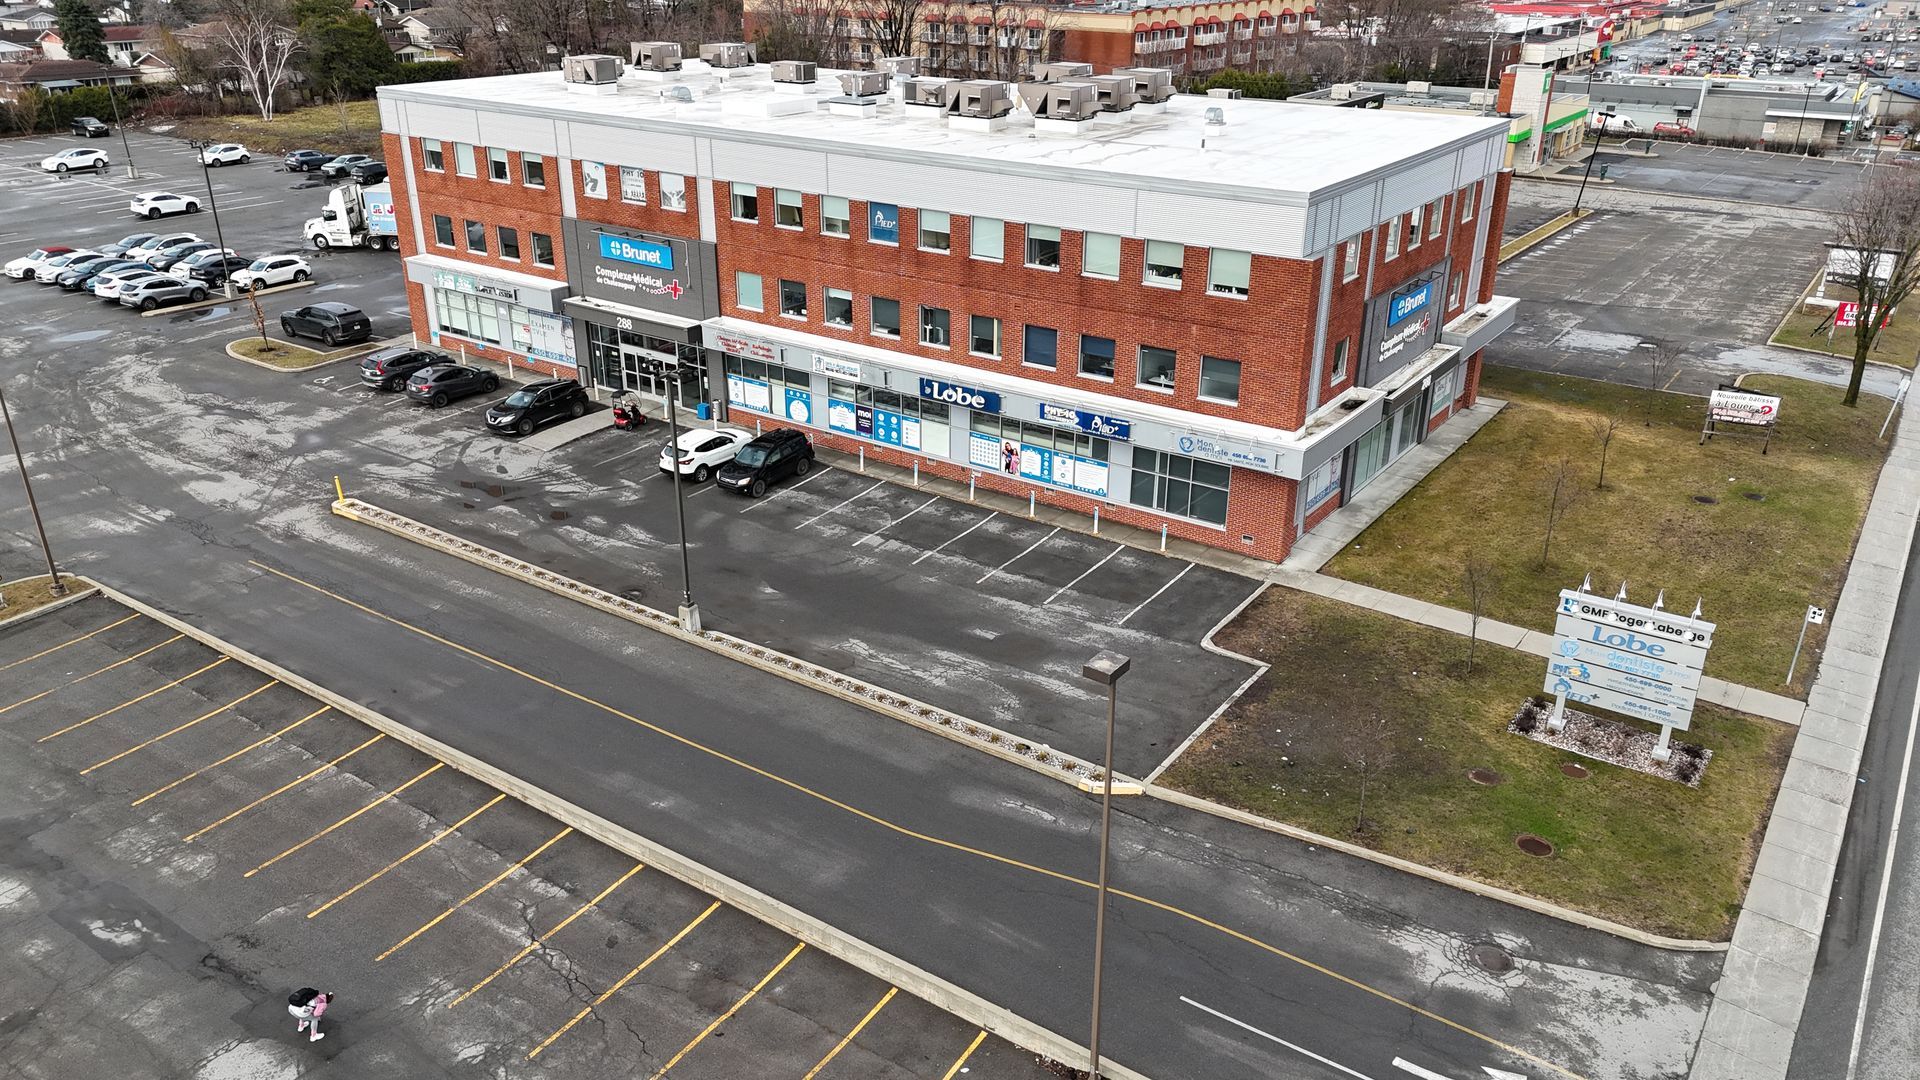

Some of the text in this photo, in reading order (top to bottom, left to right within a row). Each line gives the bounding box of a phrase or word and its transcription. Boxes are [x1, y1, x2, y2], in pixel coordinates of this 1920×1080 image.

[622, 243, 661, 264] Brunet
[1405, 288, 1426, 314] Brunet
[616, 317, 632, 330] 288
[932, 381, 985, 409] Lobe
[1716, 392, 1747, 400] Nouvelle
[857, 410, 871, 419] moi
[1197, 438, 1213, 448] Mon
[1581, 605, 1609, 619] GMF
[1653, 622, 1705, 642] Labege
[1592, 625, 1666, 657] Lobe
[1607, 650, 1665, 672] dentiste
